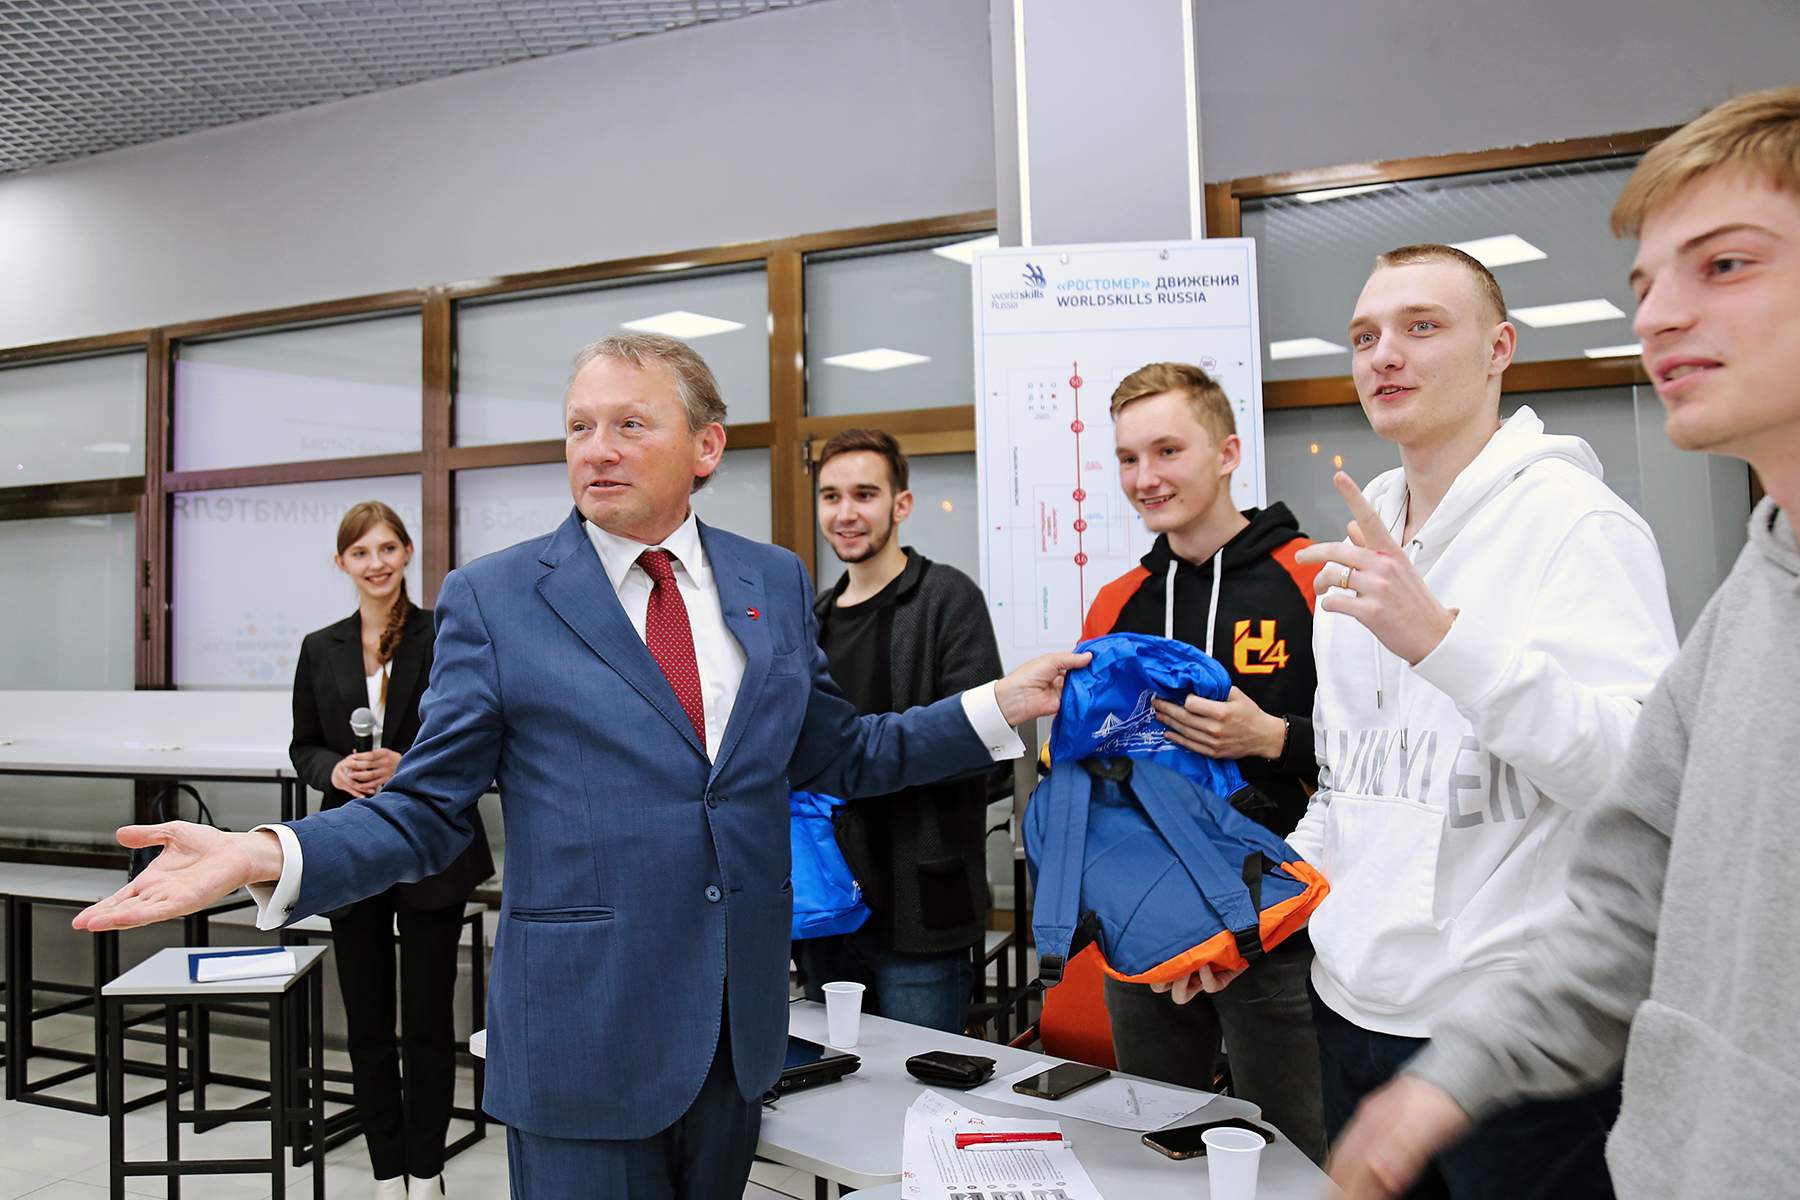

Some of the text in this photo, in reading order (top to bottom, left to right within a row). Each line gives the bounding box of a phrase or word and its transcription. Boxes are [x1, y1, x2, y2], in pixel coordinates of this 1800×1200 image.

[1057, 274, 1240, 291] «РОСТОМЕР» ДВИЖЕНИЯ
[1057, 291, 1207, 306] WORLDSKILLS RUSSIA
